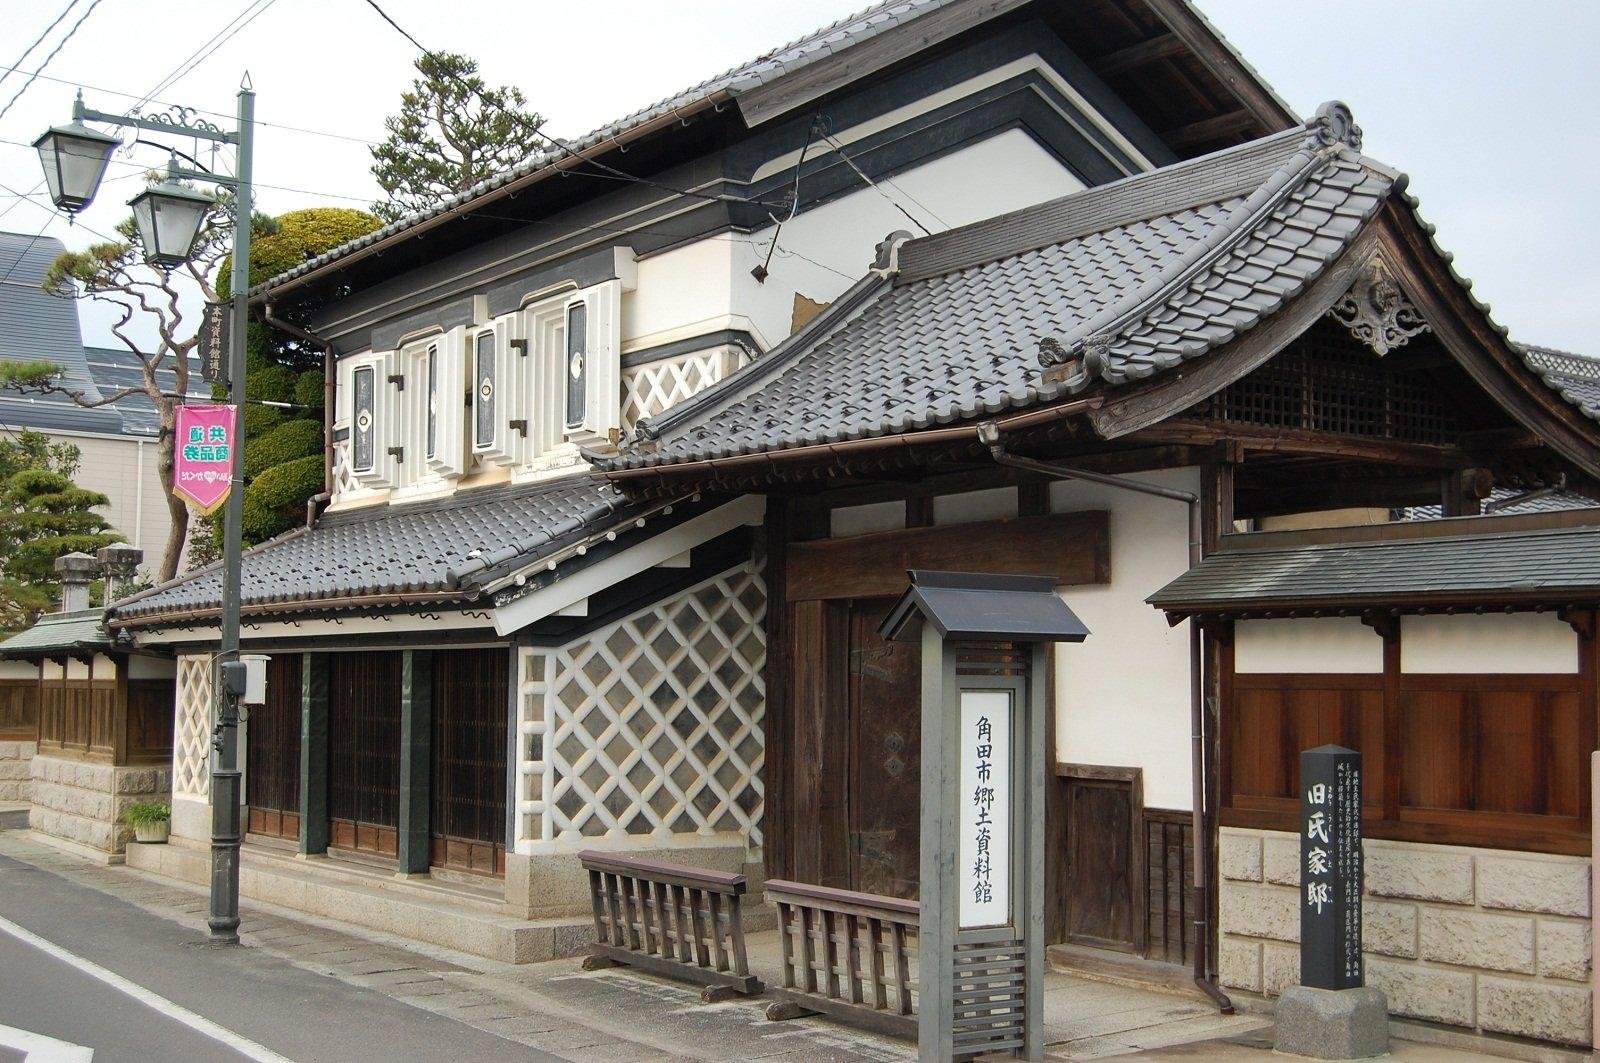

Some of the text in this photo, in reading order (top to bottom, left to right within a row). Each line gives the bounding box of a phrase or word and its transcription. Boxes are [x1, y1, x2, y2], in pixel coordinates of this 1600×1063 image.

[209, 305, 222, 379] 本町資料館通り
[973, 715, 995, 904] 角田市郷土資料館
[1307, 782, 1329, 915] 旧氏家邸
